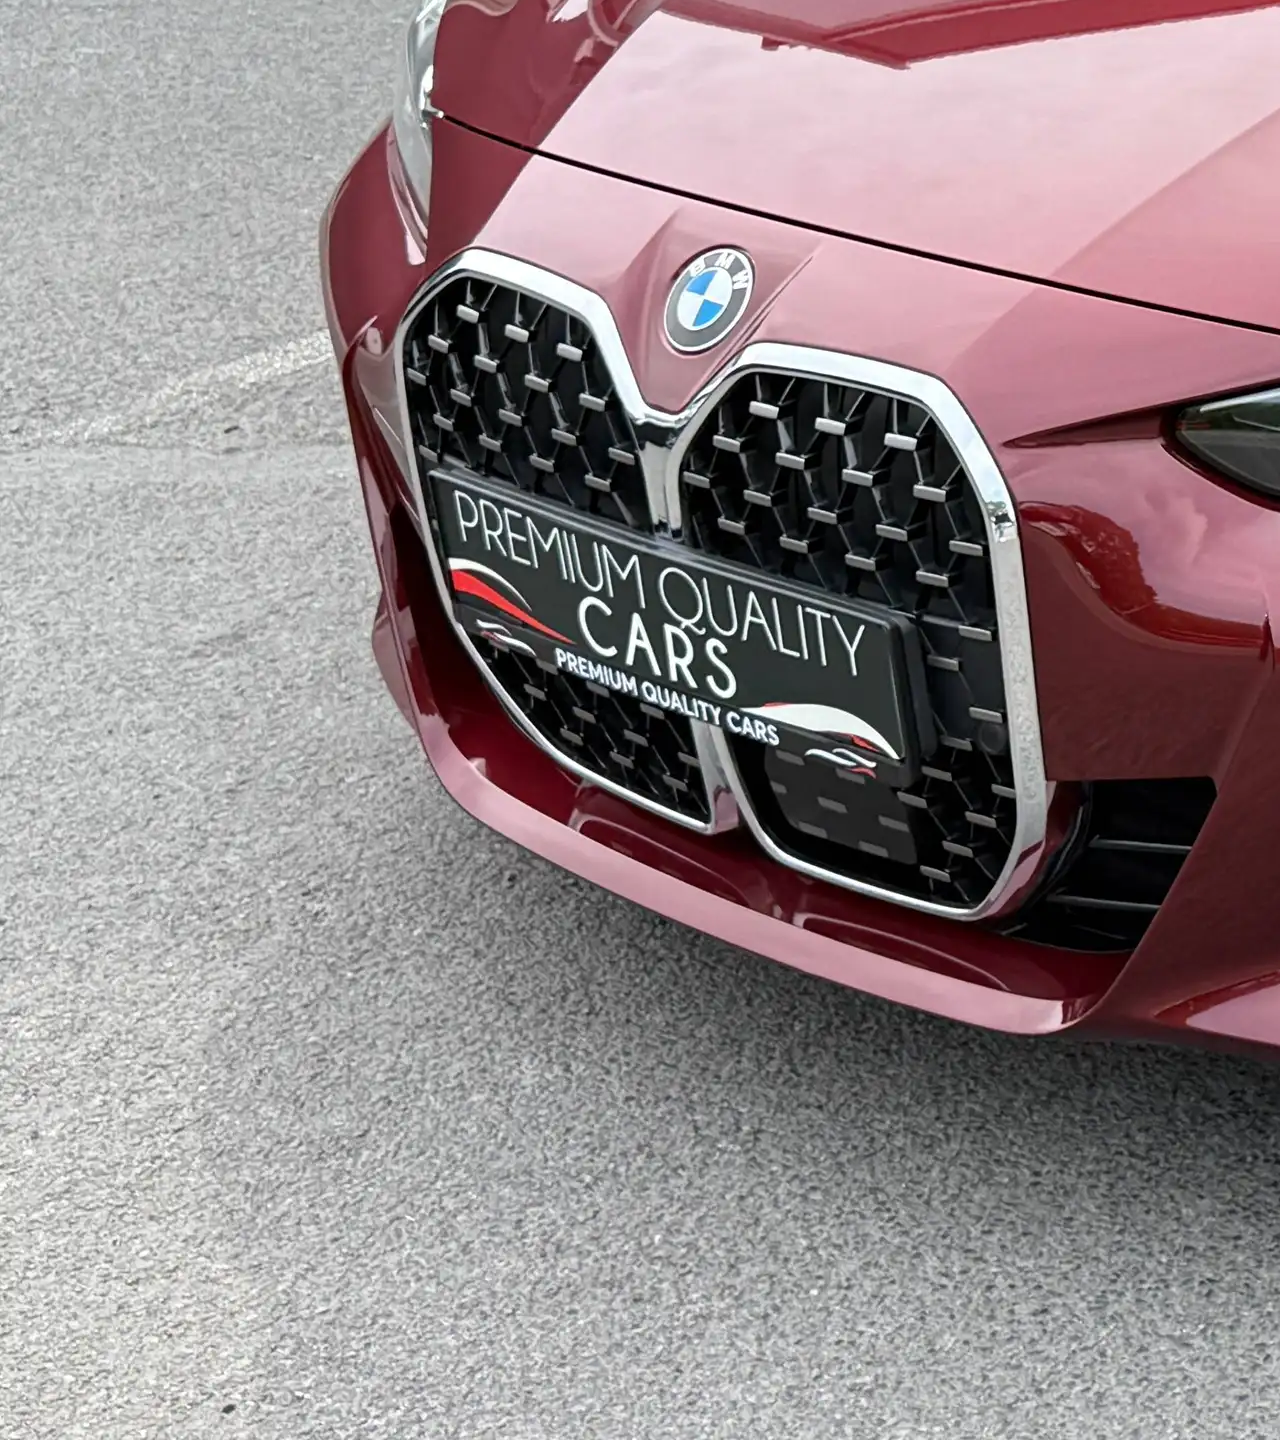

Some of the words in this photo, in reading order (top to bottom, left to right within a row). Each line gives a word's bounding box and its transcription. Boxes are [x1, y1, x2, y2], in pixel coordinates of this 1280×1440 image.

[688, 251, 750, 290] BMW
[454, 489, 647, 610] PREMIUM
[658, 566, 866, 677] QUALITY
[554, 647, 639, 697] PREMIUM
[640, 680, 722, 727] QUALITY
[726, 710, 781, 747] CARS
[577, 596, 738, 700] CARS
